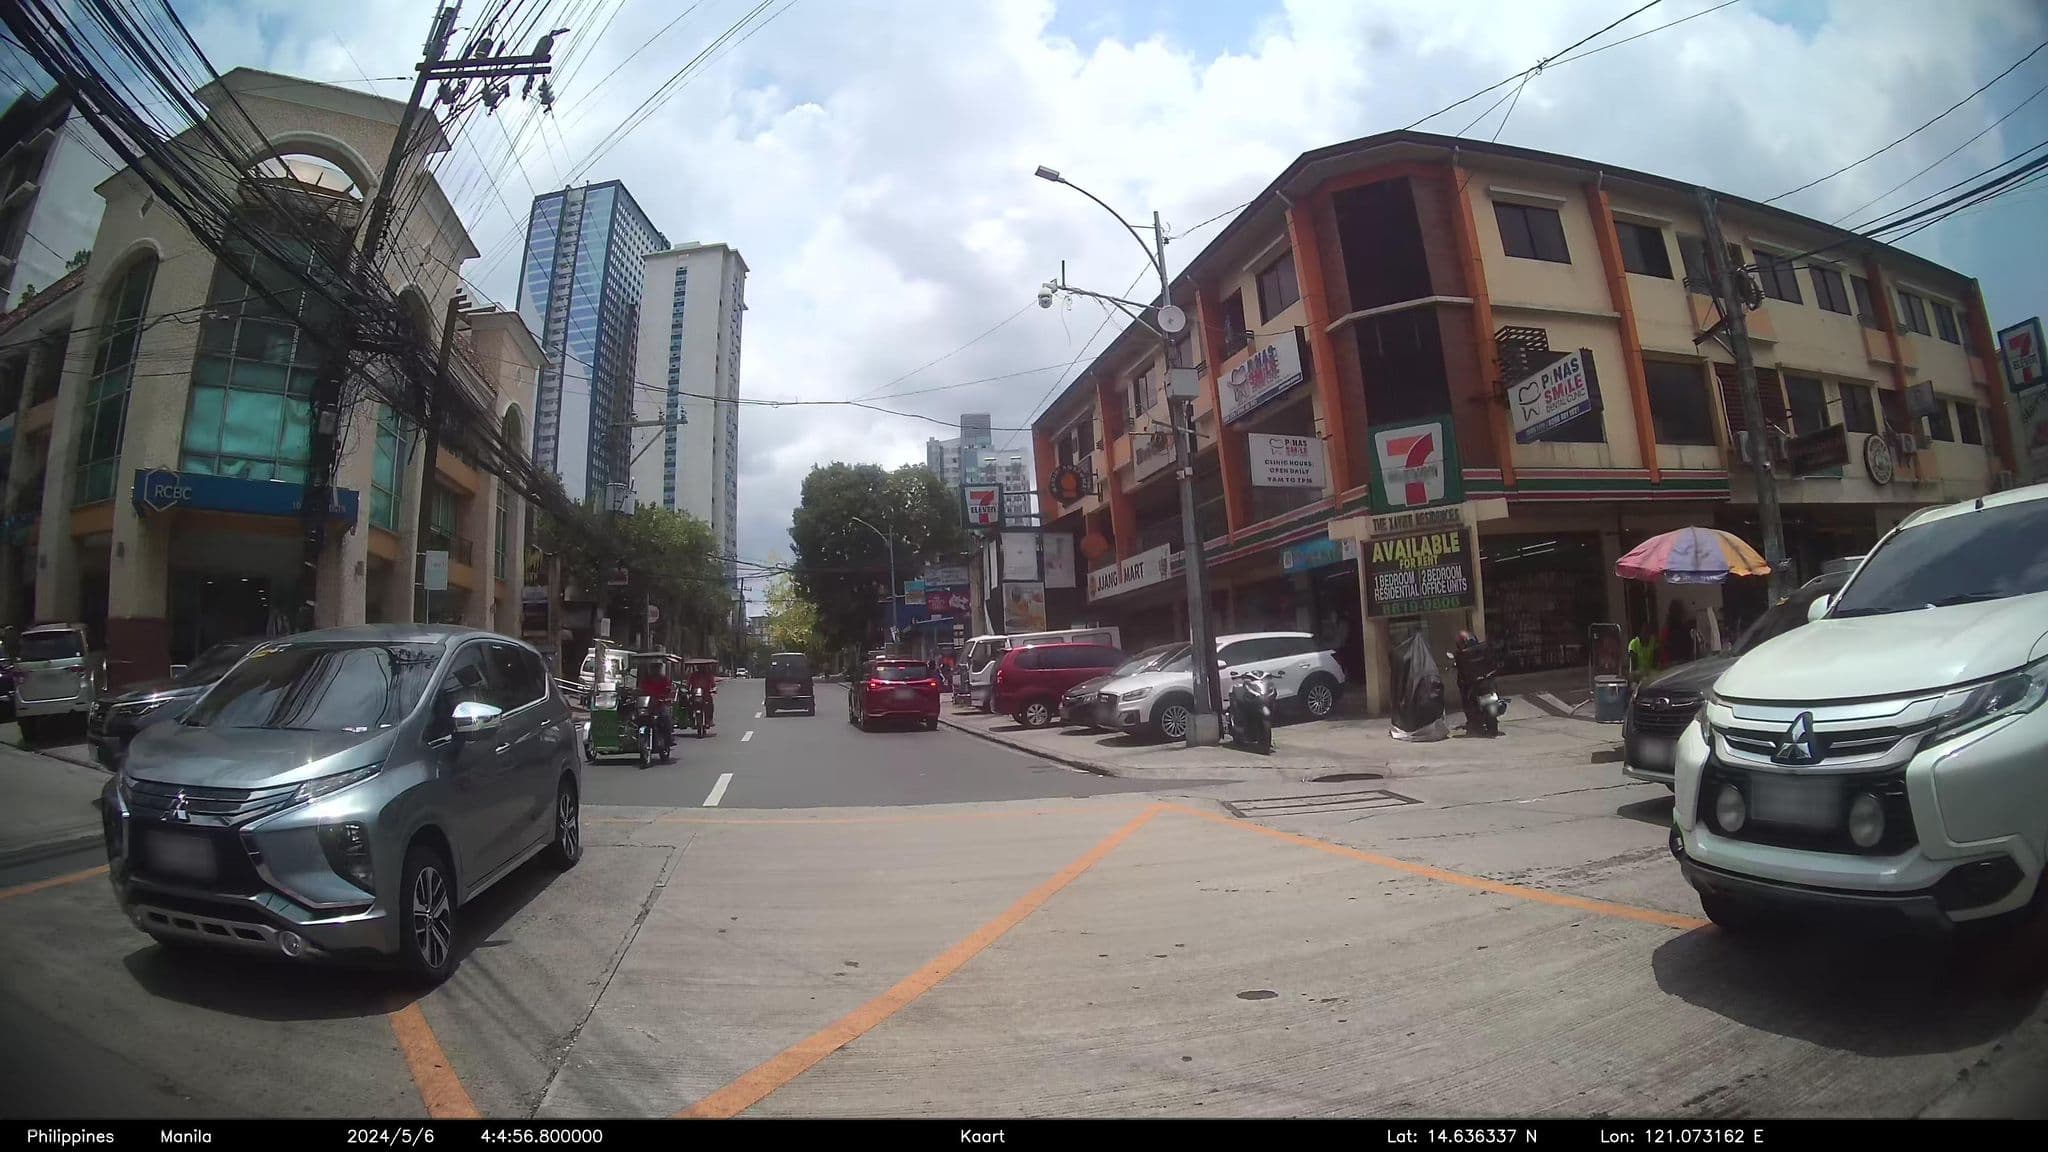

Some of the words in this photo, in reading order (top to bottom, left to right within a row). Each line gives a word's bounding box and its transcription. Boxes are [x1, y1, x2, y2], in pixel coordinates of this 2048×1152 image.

[1386, 432, 1434, 507] 7
[154, 484, 192, 501] RCBC
[1373, 517, 1388, 531] THE
[1373, 531, 1460, 563] AVAILABLE
[1399, 557, 1416, 570] FOR
[1417, 554, 1439, 569] RENT
[1097, 571, 1118, 592] JJANG
[1123, 561, 1145, 584] MART
[1379, 571, 1415, 588] BEDROOM
[1427, 565, 1463, 582] BEDROOM
[1374, 583, 1420, 601] RESIDENTIAL
[1421, 581, 1447, 595] OFFICE
[1446, 577, 1468, 593] UNITS
